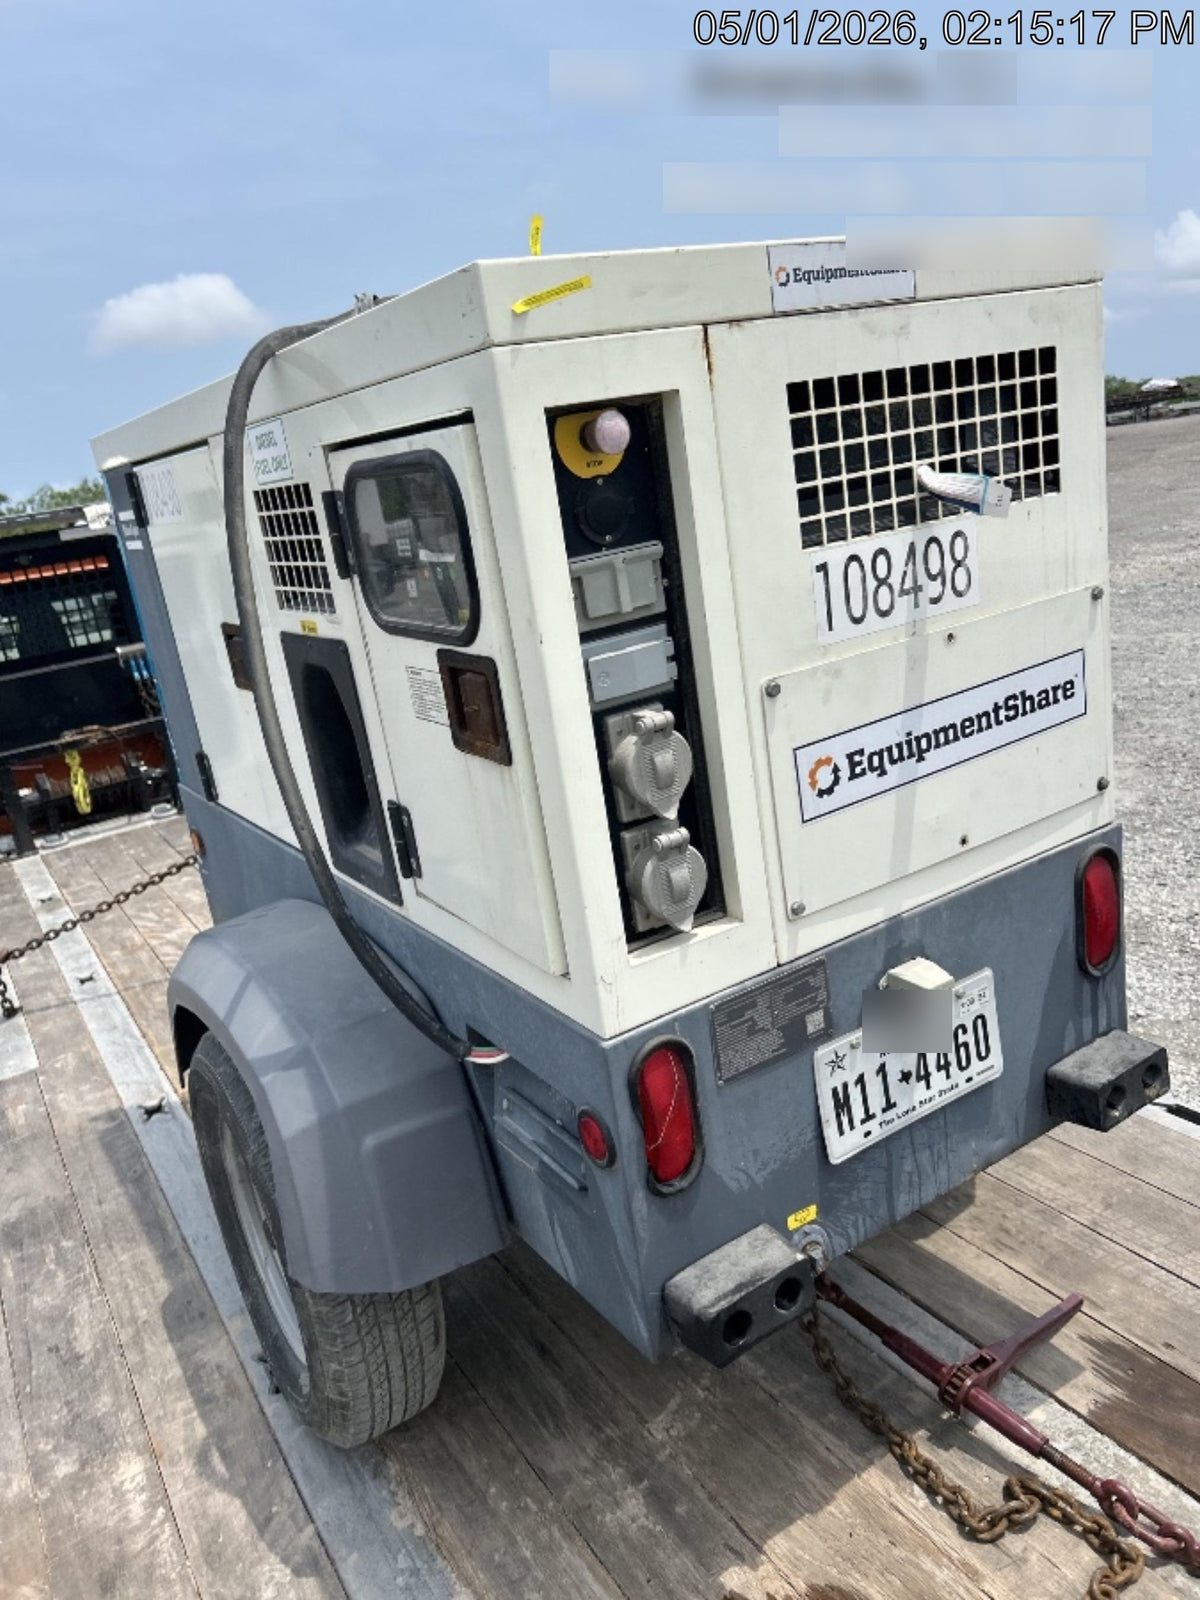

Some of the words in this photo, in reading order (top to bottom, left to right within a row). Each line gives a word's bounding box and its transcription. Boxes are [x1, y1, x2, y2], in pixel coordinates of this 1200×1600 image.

[815, 529, 972, 632] 108498
[845, 678, 1076, 777] EquipmentShare
[831, 1060, 898, 1137] M11
[915, 1013, 991, 1091] 4460
